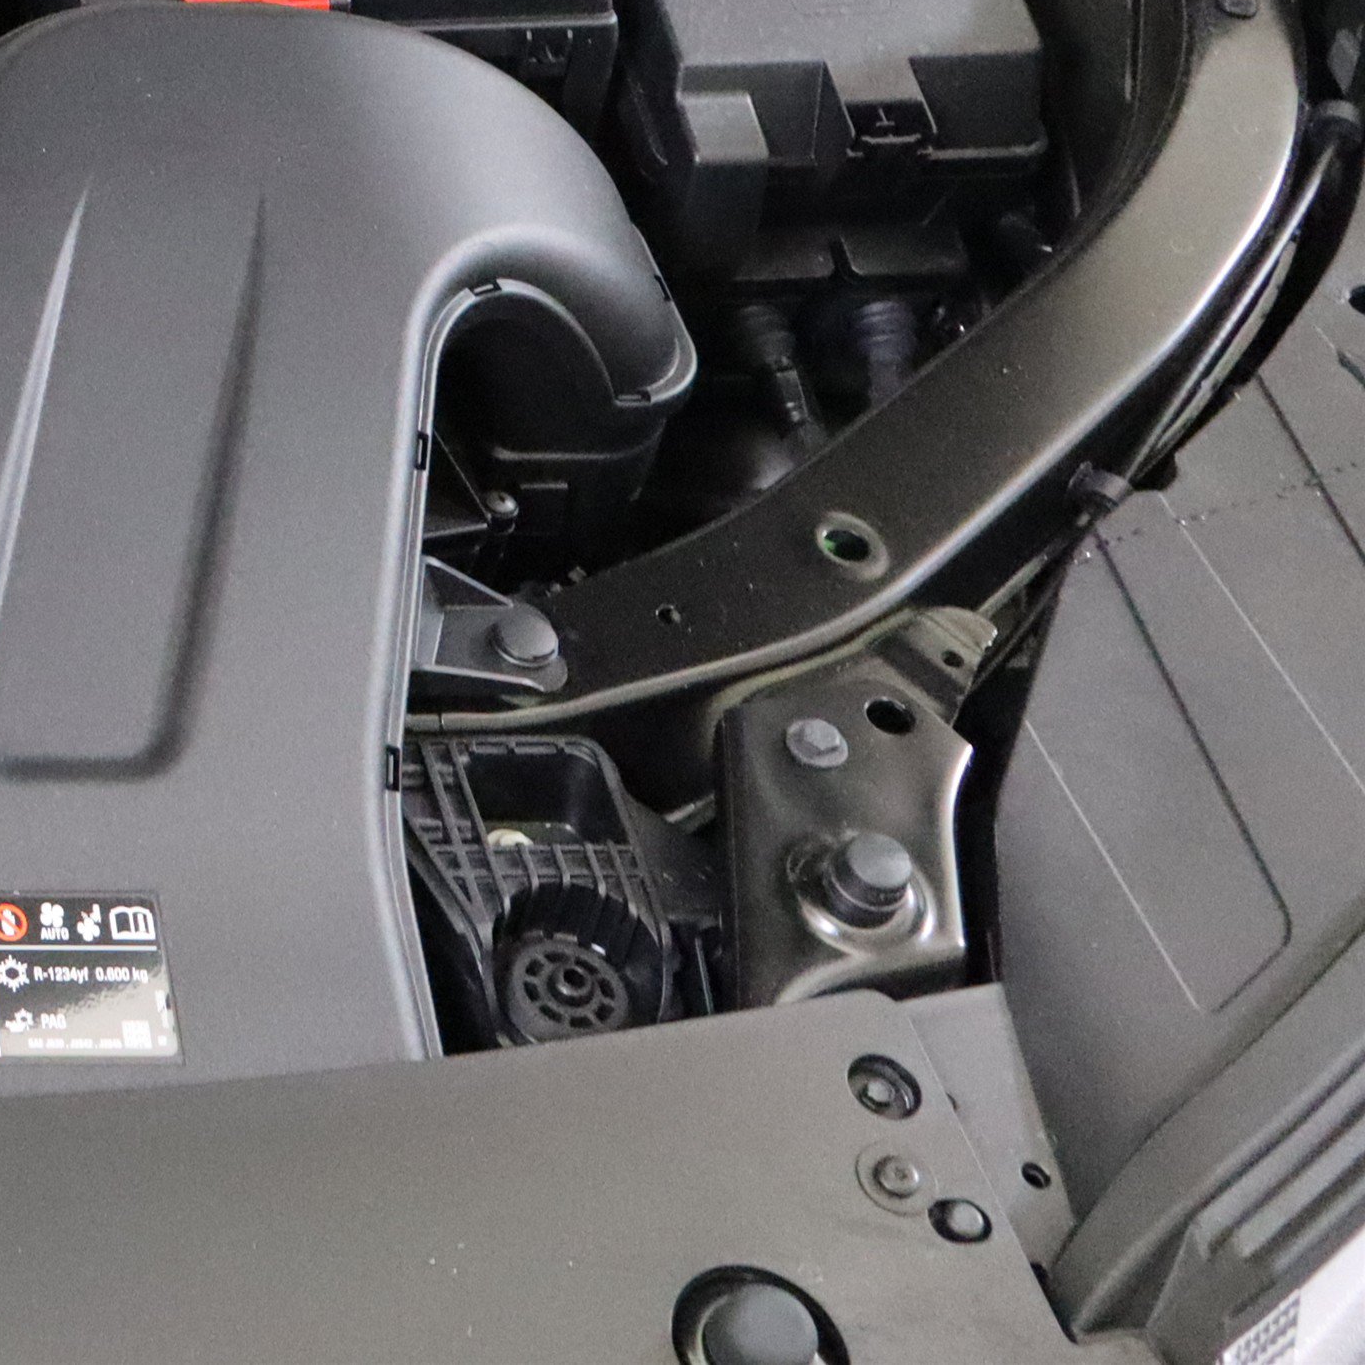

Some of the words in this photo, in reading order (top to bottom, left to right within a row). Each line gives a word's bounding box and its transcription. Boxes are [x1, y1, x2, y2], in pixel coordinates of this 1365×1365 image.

[40, 927, 69, 941] AUTO
[33, 966, 89, 984] R-1234yf
[132, 966, 149, 983] kg
